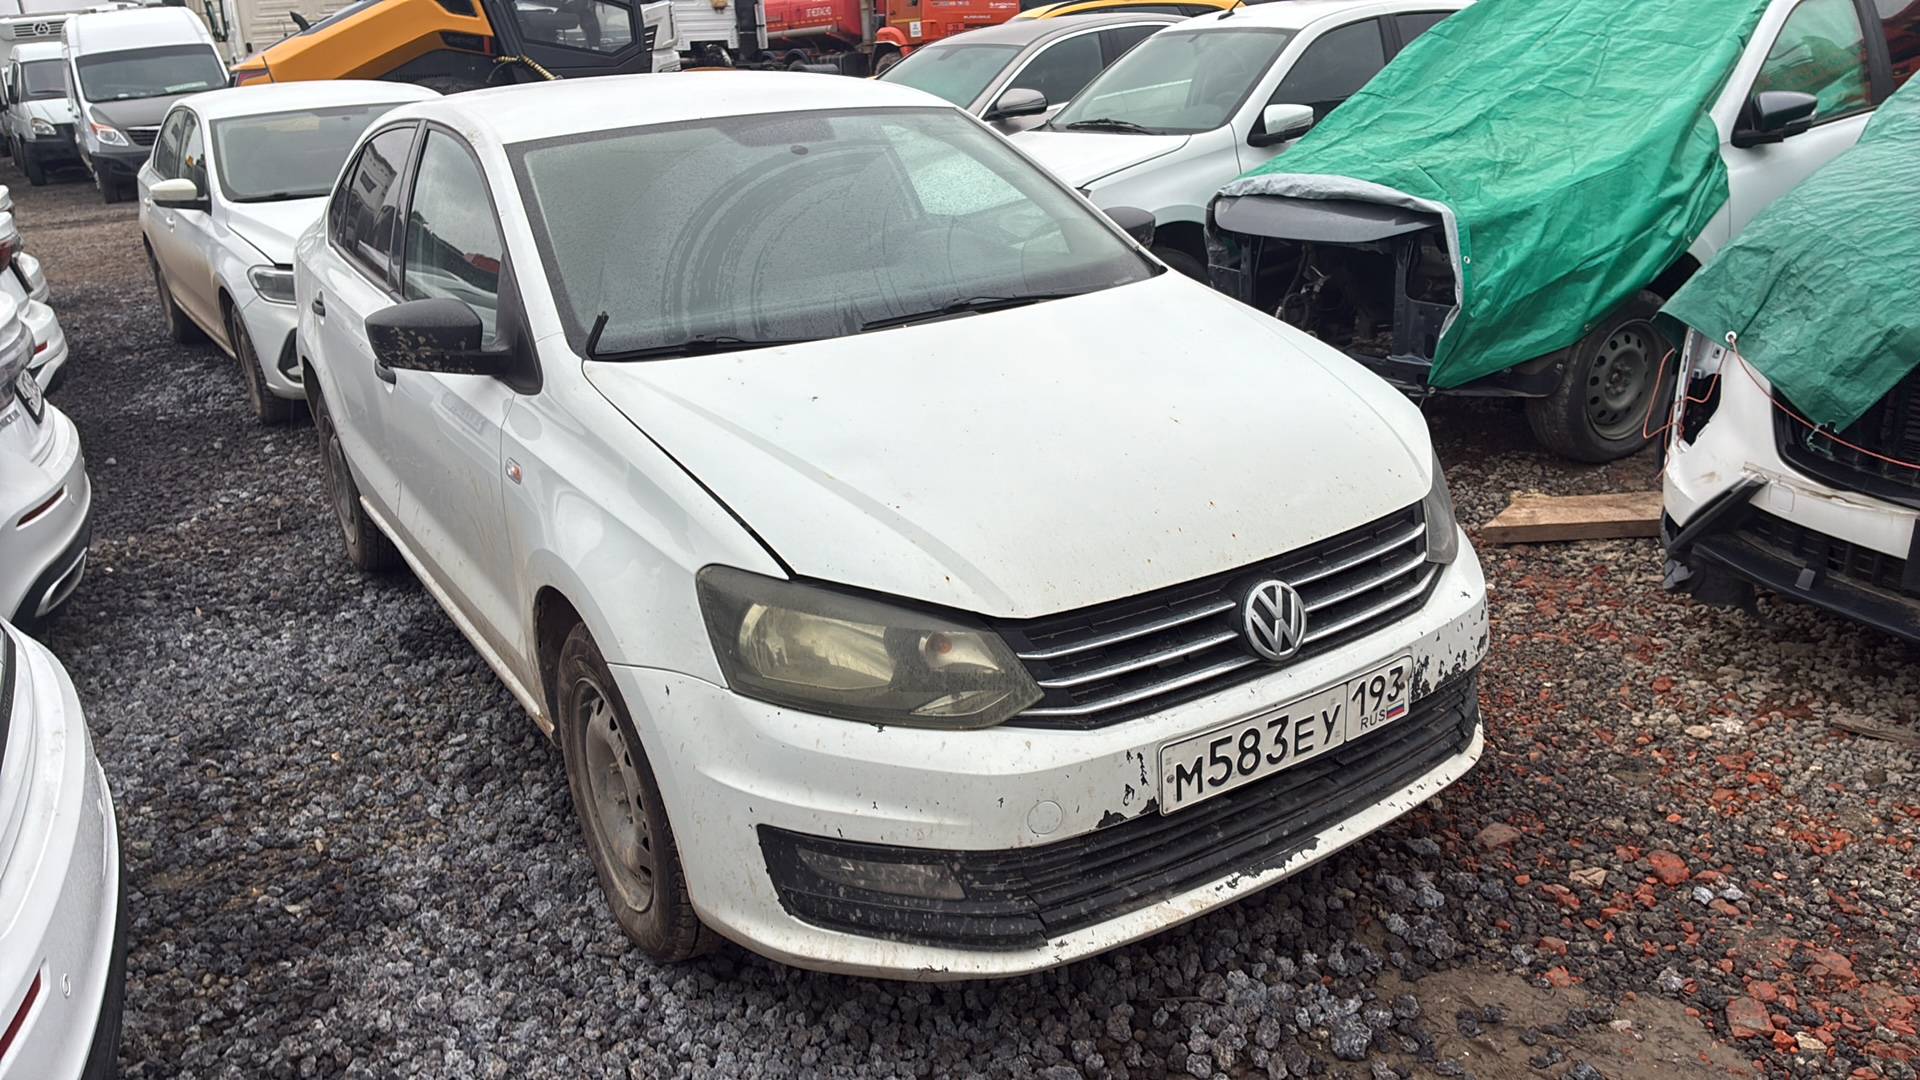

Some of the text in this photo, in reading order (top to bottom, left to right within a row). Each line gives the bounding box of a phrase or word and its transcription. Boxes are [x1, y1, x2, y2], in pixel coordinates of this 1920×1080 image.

[1175, 665, 1404, 802] М583ЕУ 193
[1360, 711, 1386, 731] RUS
